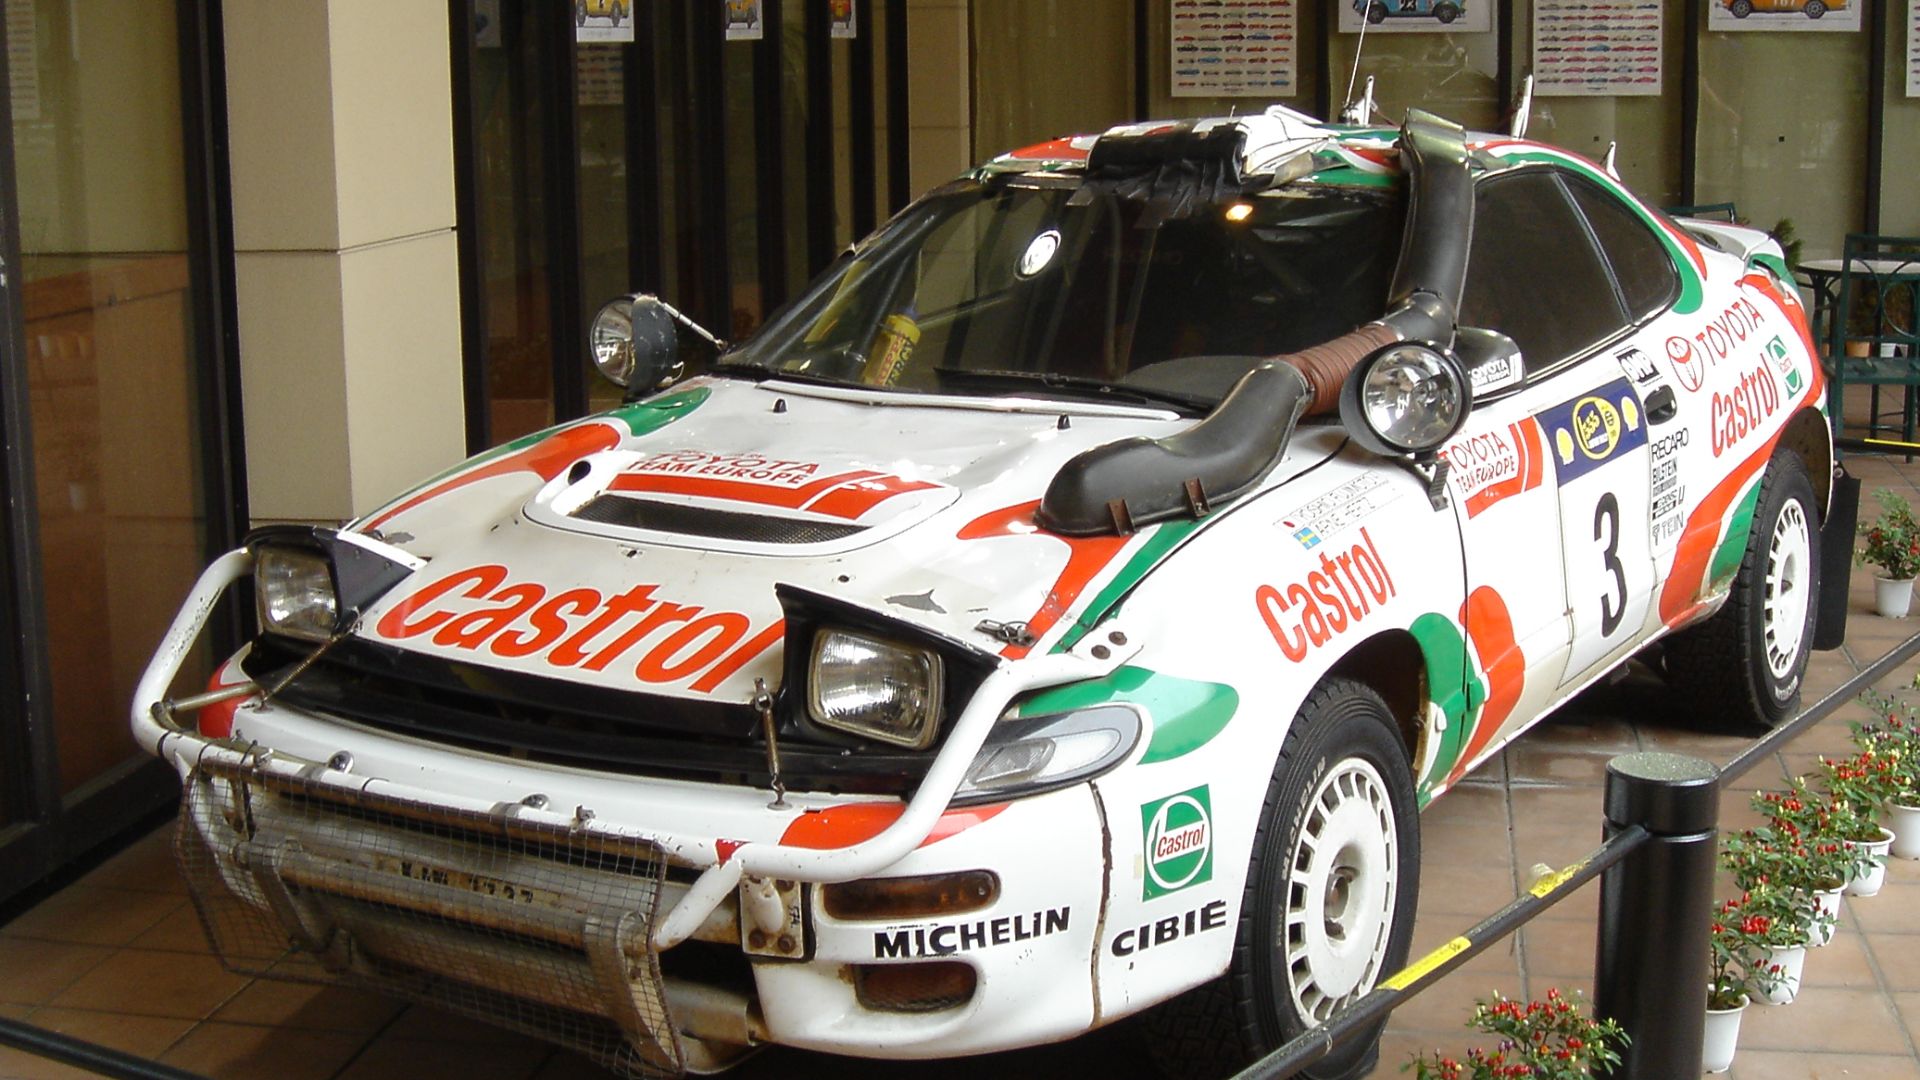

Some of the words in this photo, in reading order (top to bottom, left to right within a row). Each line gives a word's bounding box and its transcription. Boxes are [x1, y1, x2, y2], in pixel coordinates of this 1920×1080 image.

[1695, 297, 1765, 366] TOYOTA
[1467, 358, 1511, 380] OYOTA
[1711, 353, 1780, 458] Castrol
[651, 453, 819, 475] TOYOTA
[1435, 431, 1510, 474] TOYOTA
[1651, 427, 1689, 462] RECARO
[627, 460, 698, 472] TEAM
[697, 465, 809, 485] EUROPE
[1475, 455, 1516, 484] EUROPE
[1594, 492, 1628, 638] 3
[1255, 526, 1397, 663] Castrol
[376, 564, 786, 694] Castrol
[1156, 823, 1205, 858] Castrol
[873, 906, 1071, 959] MICHELIN
